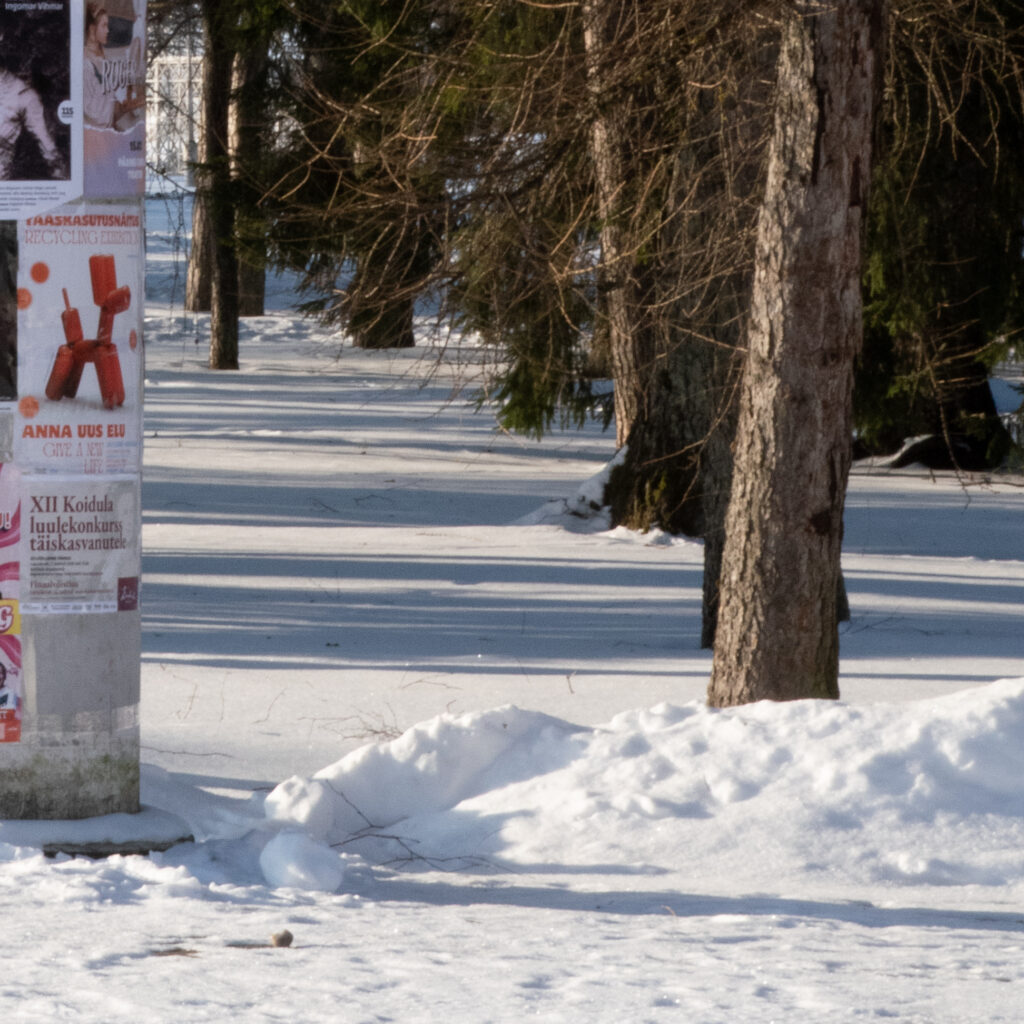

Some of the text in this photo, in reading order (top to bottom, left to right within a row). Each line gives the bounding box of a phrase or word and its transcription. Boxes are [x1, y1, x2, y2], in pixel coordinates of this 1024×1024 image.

[25, 229, 98, 245] RECYCLING
[22, 424, 125, 438] ANNA UUS ELU
[30, 495, 114, 513] XII Koidula
[30, 516, 123, 534] luulekonkurss
[30, 532, 127, 552] täiskasvanutele
